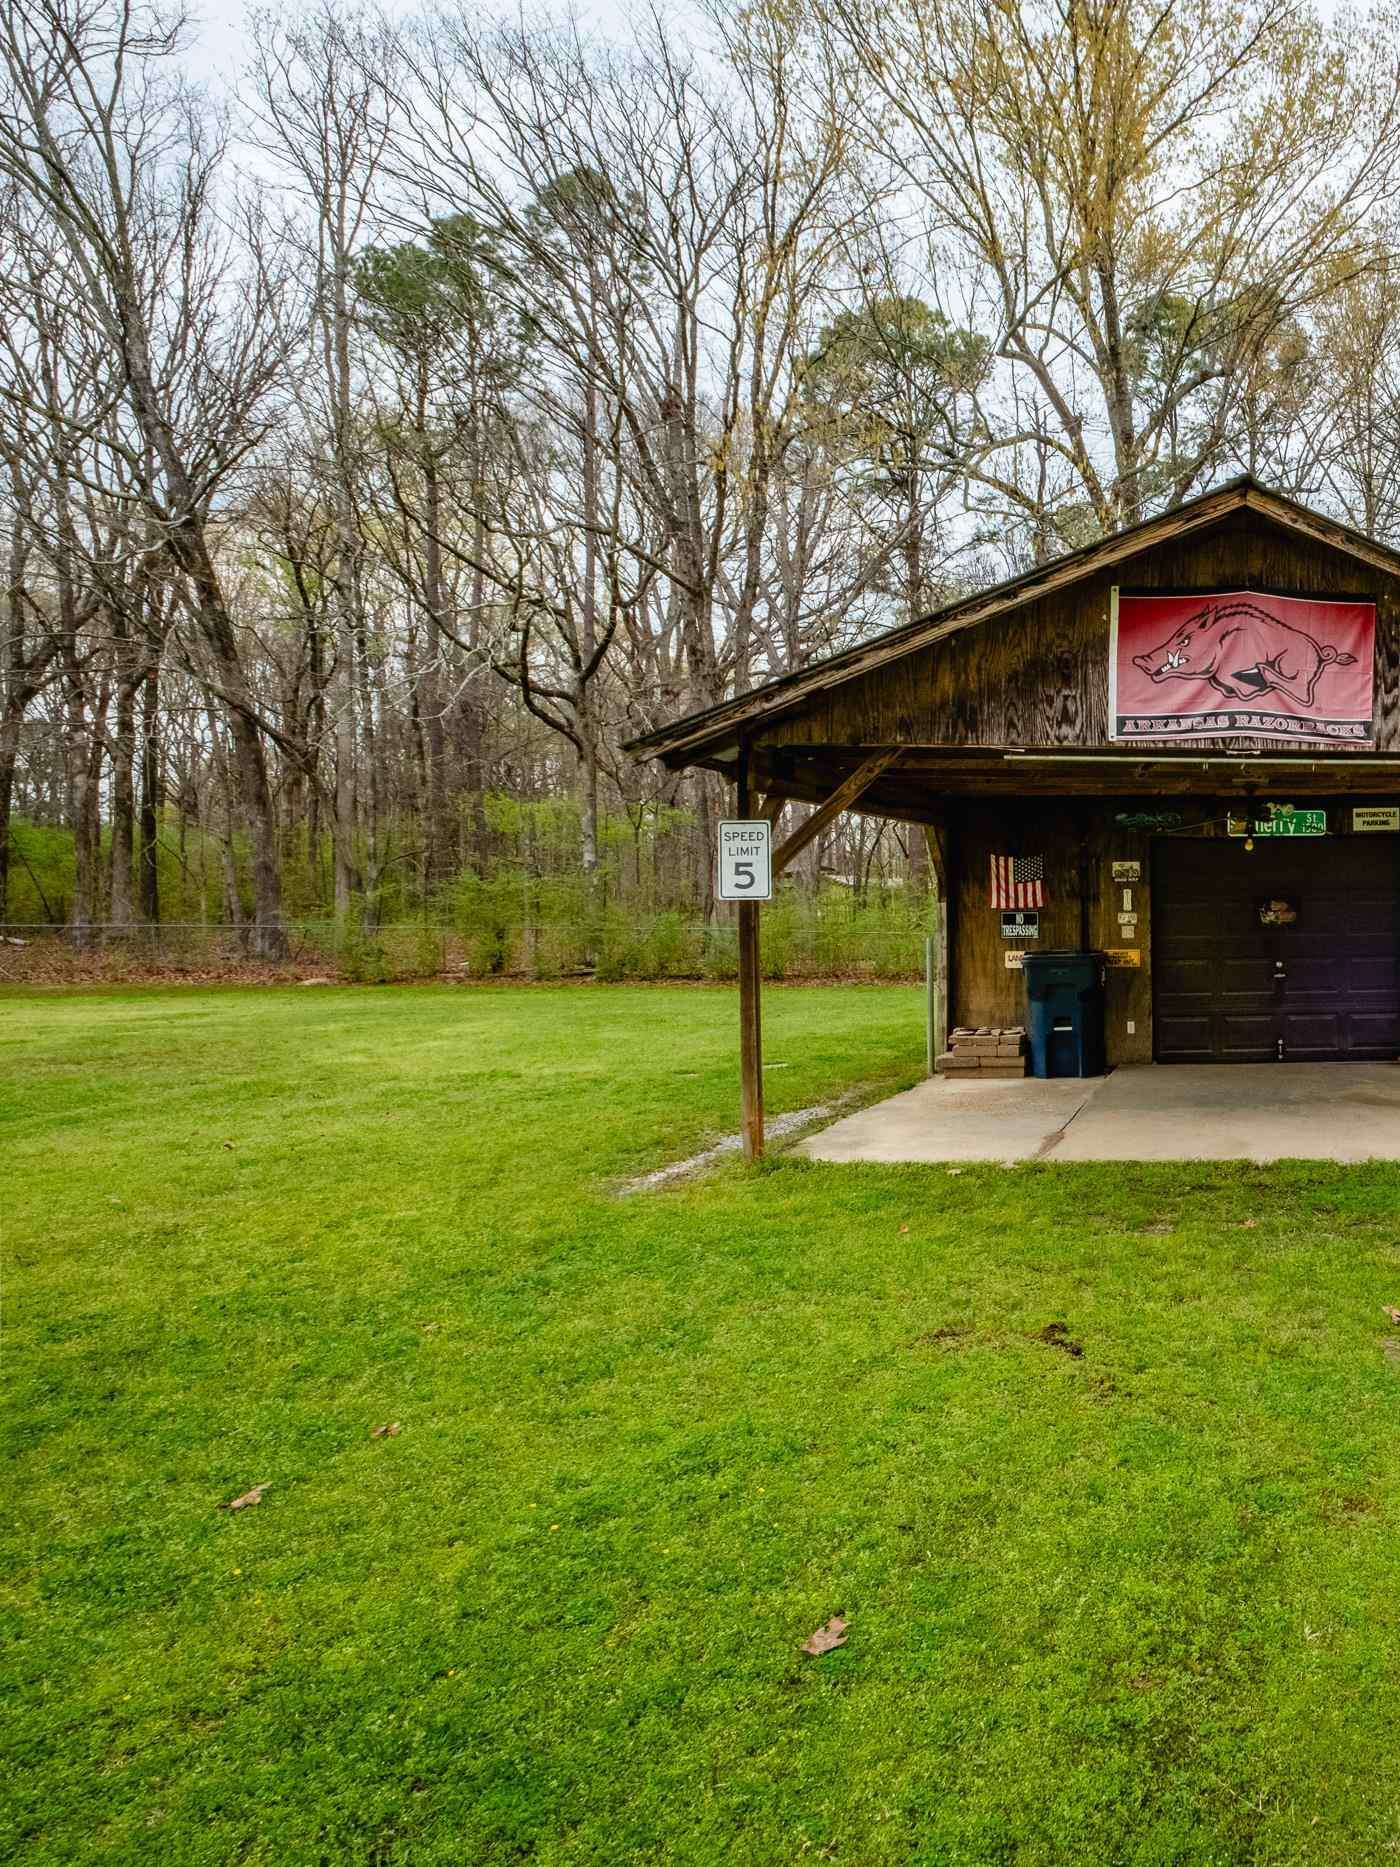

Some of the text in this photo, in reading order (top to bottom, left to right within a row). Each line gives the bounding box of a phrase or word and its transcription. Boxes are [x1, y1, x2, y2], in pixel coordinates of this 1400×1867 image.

[1122, 714, 1367, 737] ARKANSAS RAZORBACKS
[724, 831, 765, 842] SPEED
[728, 846, 760, 857] LIMIT
[734, 862, 756, 890] 5
[1015, 912, 1024, 925] NO
[1002, 925, 1038, 937] TRESPASSING
